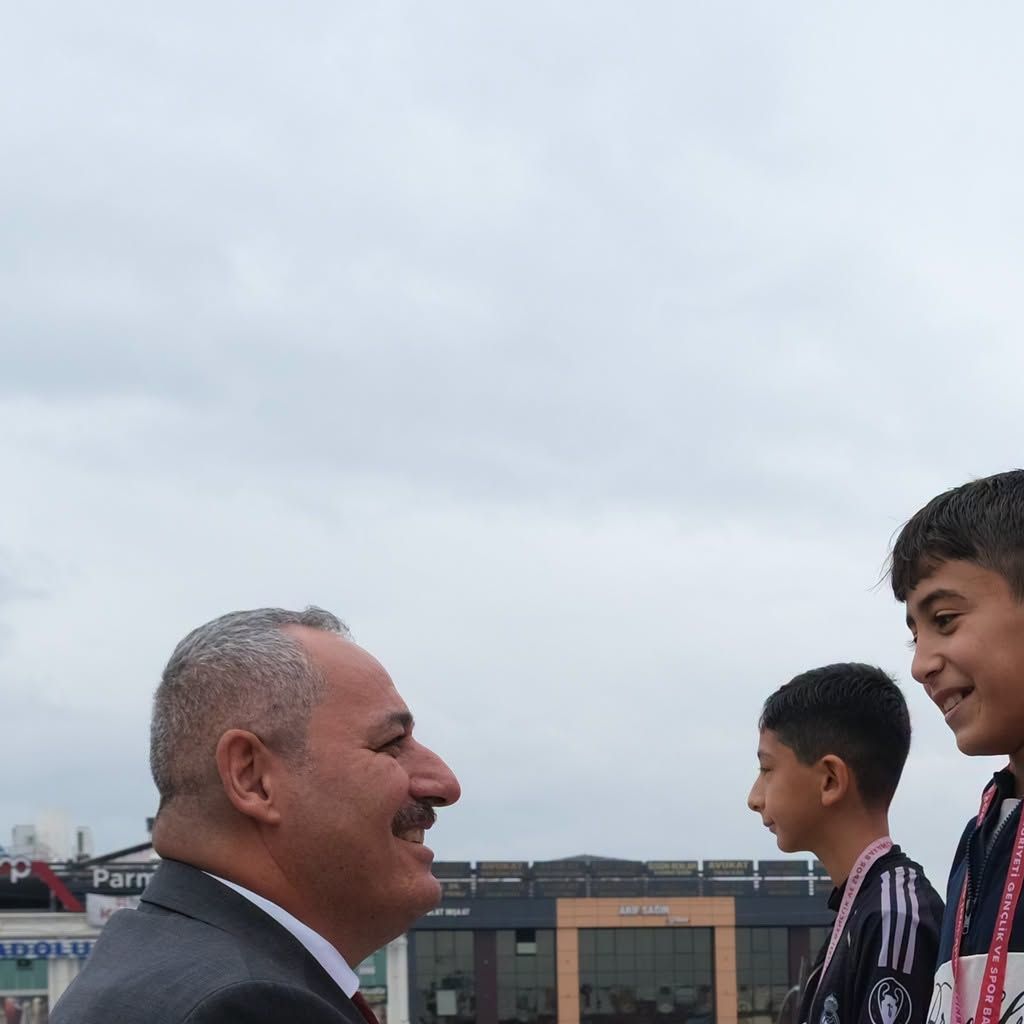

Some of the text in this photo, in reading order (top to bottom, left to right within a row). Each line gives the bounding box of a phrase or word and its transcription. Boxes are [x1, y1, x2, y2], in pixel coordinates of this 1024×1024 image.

[995, 882, 1016, 941] GENÇLİK
[992, 946, 1002, 962] VE
[984, 967, 999, 1003] SPOR
